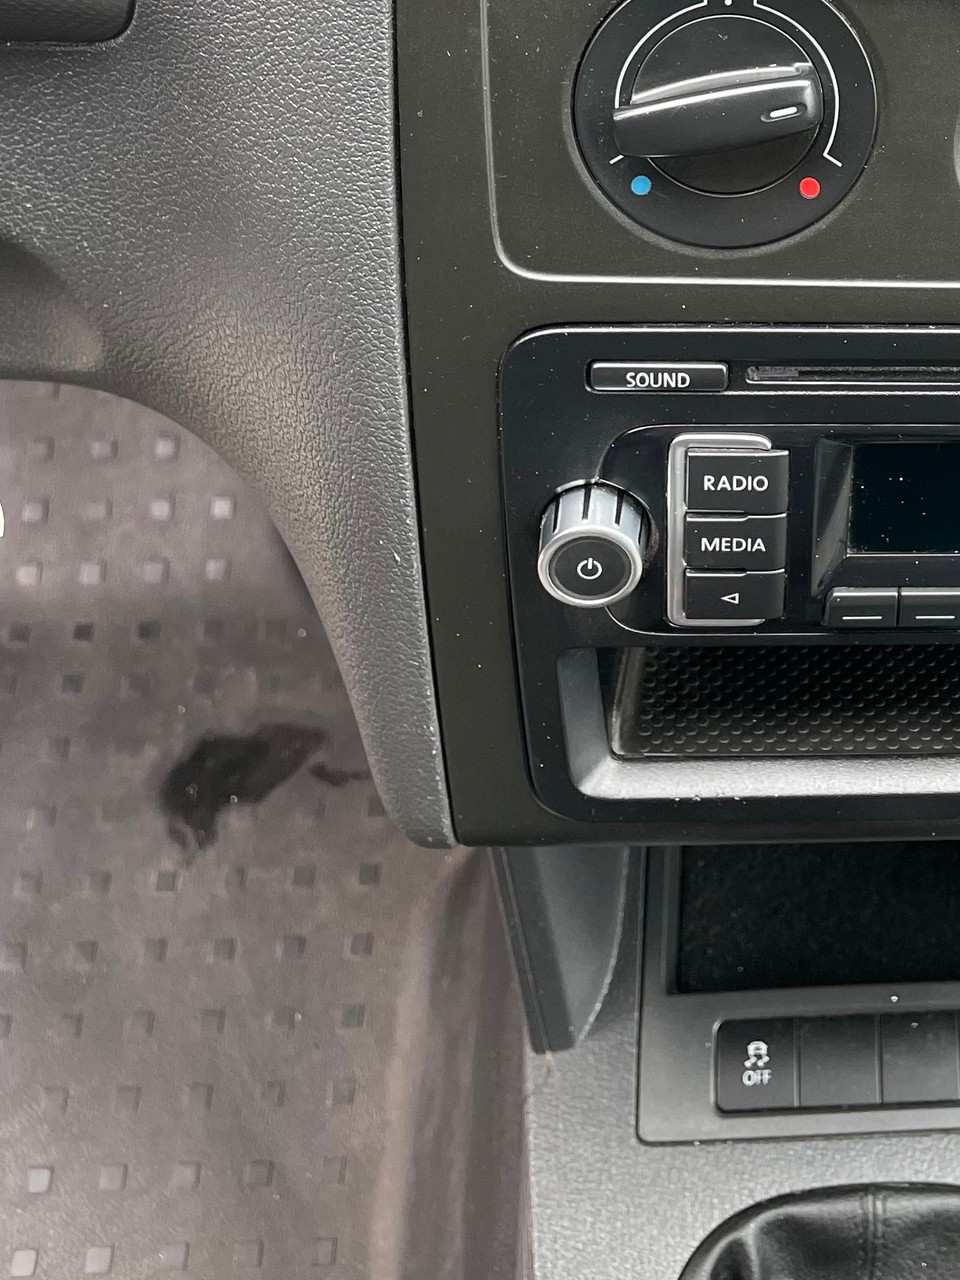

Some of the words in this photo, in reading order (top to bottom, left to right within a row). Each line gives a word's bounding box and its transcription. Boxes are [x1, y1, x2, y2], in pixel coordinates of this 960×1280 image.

[625, 371, 691, 389] SOUND
[702, 474, 770, 492] RADIO
[700, 536, 767, 553] MEDIA
[741, 1068, 773, 1087] OFF
